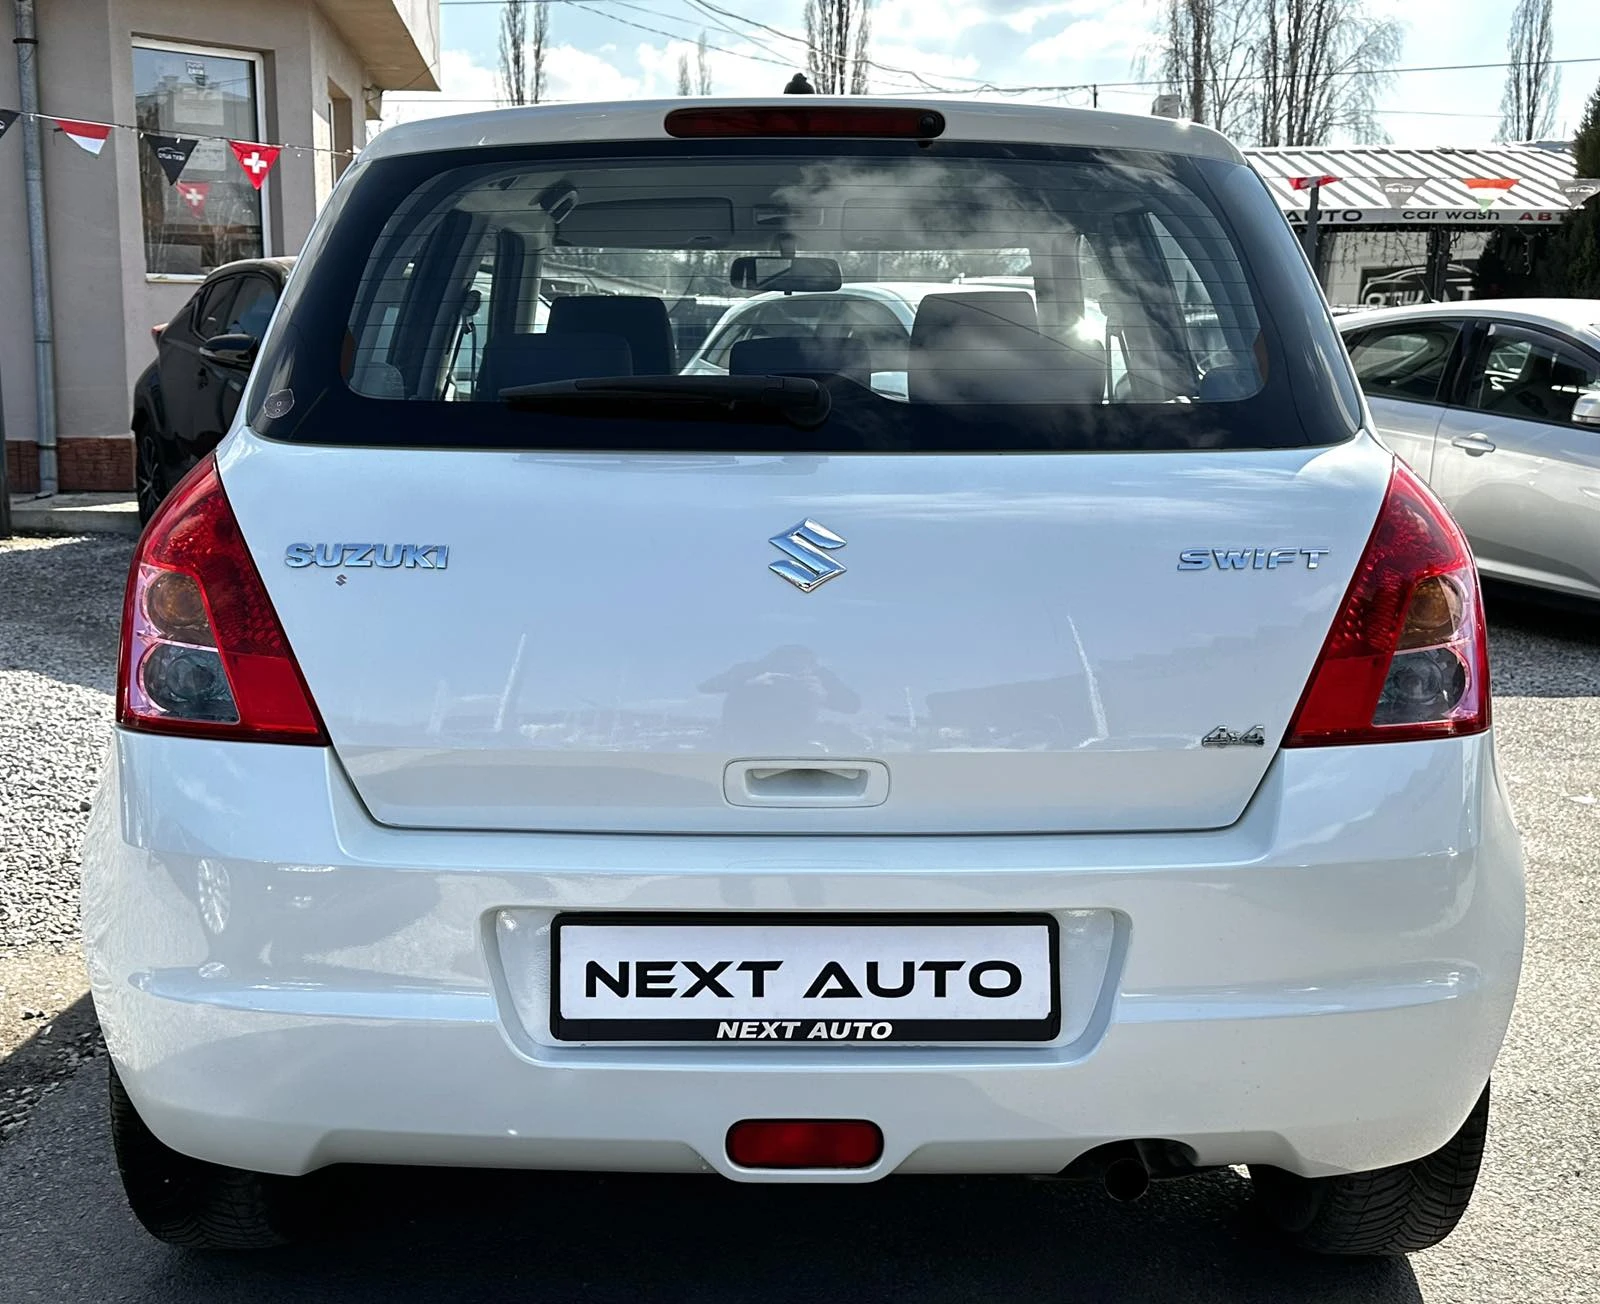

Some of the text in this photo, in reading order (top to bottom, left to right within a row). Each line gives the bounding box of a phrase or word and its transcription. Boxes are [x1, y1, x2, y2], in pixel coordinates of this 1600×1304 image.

[1402, 210, 1500, 221] car wash
[285, 543, 449, 570] SUZUKI
[1177, 547, 1331, 571] SWIFT
[1201, 725, 1265, 747] 4x4
[585, 960, 1022, 998] NEXT AUTO
[716, 1021, 893, 1039] NEXT AUTO
